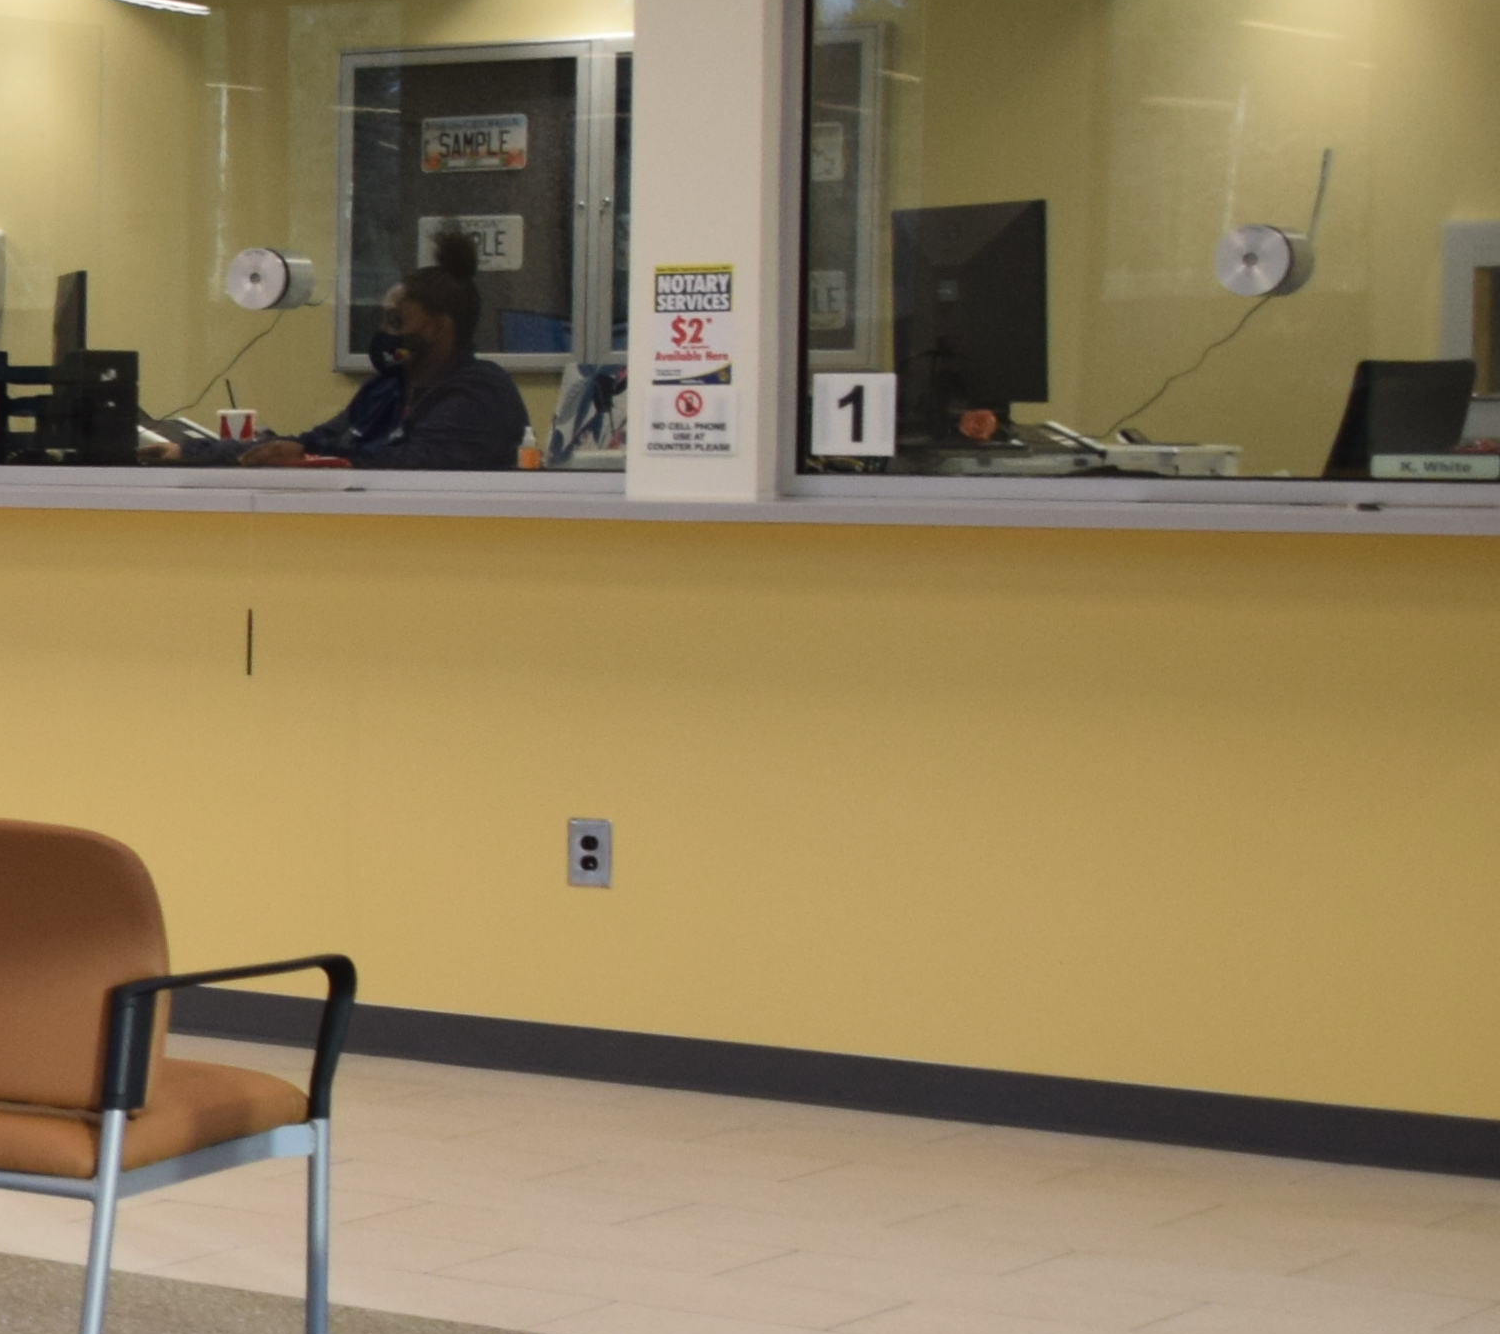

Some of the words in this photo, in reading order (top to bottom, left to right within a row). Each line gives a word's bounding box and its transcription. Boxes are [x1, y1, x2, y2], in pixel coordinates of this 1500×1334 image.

[439, 131, 511, 157] SAMPLE
[657, 274, 730, 293] NOTARY
[657, 294, 730, 311] SERVICES
[655, 351, 702, 361] Available
[705, 351, 729, 361] Here
[838, 384, 864, 443] 1
[652, 422, 666, 431] NO
[668, 422, 691, 431] CELL
[694, 422, 726, 431] PHONE
[673, 433, 691, 441] USE
[694, 433, 705, 441] AT
[647, 443, 691, 451] COUNTER
[694, 443, 730, 451] PLEASE
[1423, 461, 1472, 473] White
